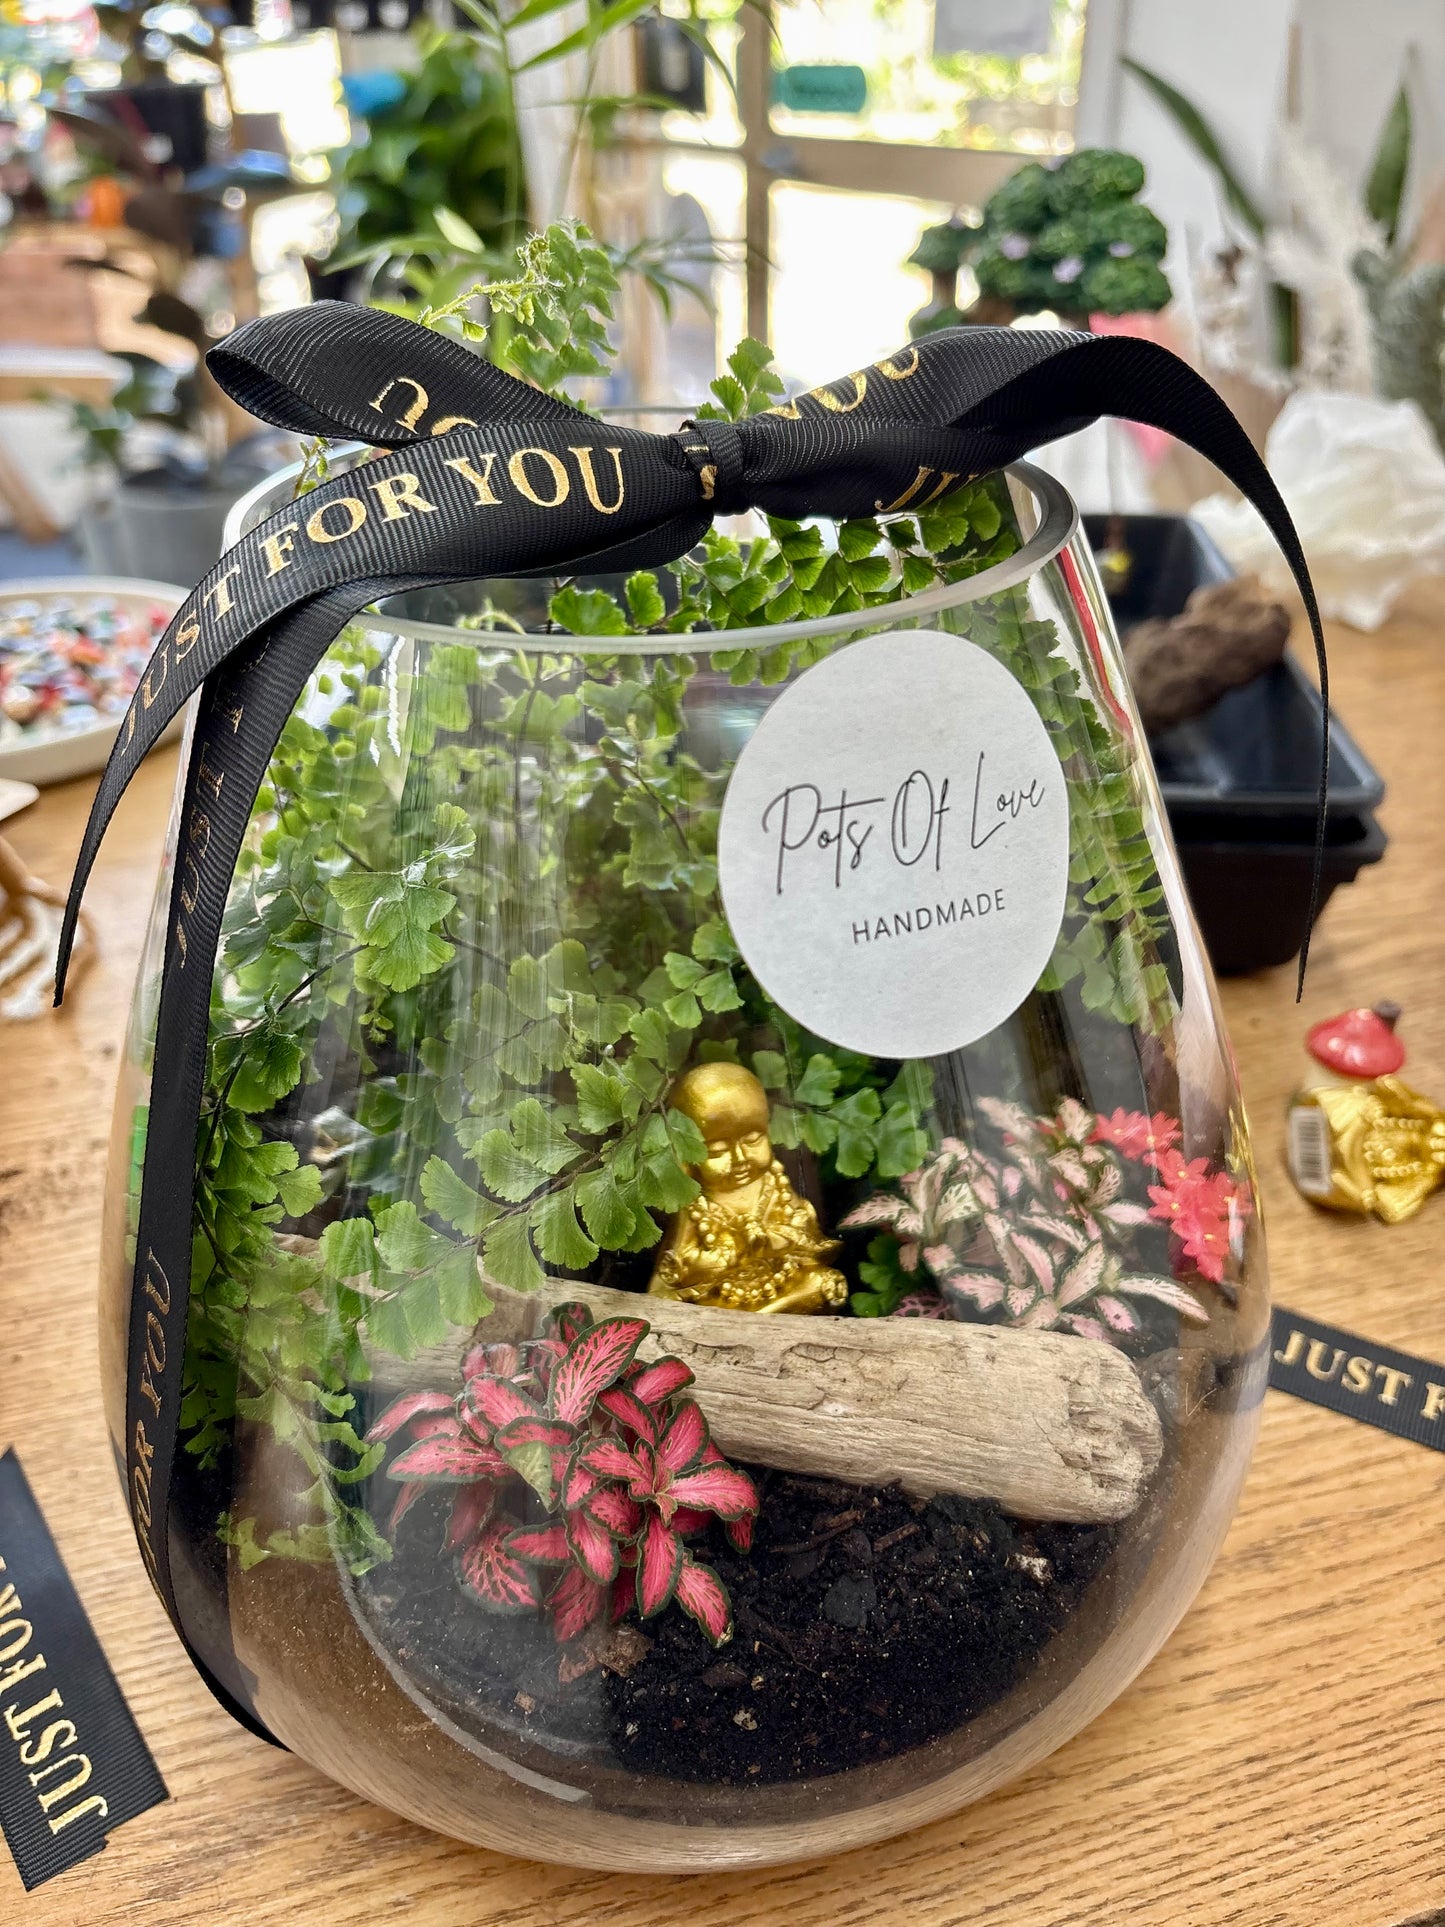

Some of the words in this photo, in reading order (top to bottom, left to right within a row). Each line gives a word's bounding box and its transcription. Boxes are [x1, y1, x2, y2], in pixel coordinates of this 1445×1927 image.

[121, 564, 241, 757] JUST
[258, 472, 438, 579] FOR
[443, 447, 625, 515] YOU
[762, 783, 885, 894] Pots
[891, 770, 950, 871] Of
[971, 751, 1045, 850] Love
[851, 888, 1006, 944] HANDMADE
[141, 1246, 171, 1418] YOU
[1273, 1329, 1416, 1407] JUST
[3, 1688, 109, 1836] JUST
